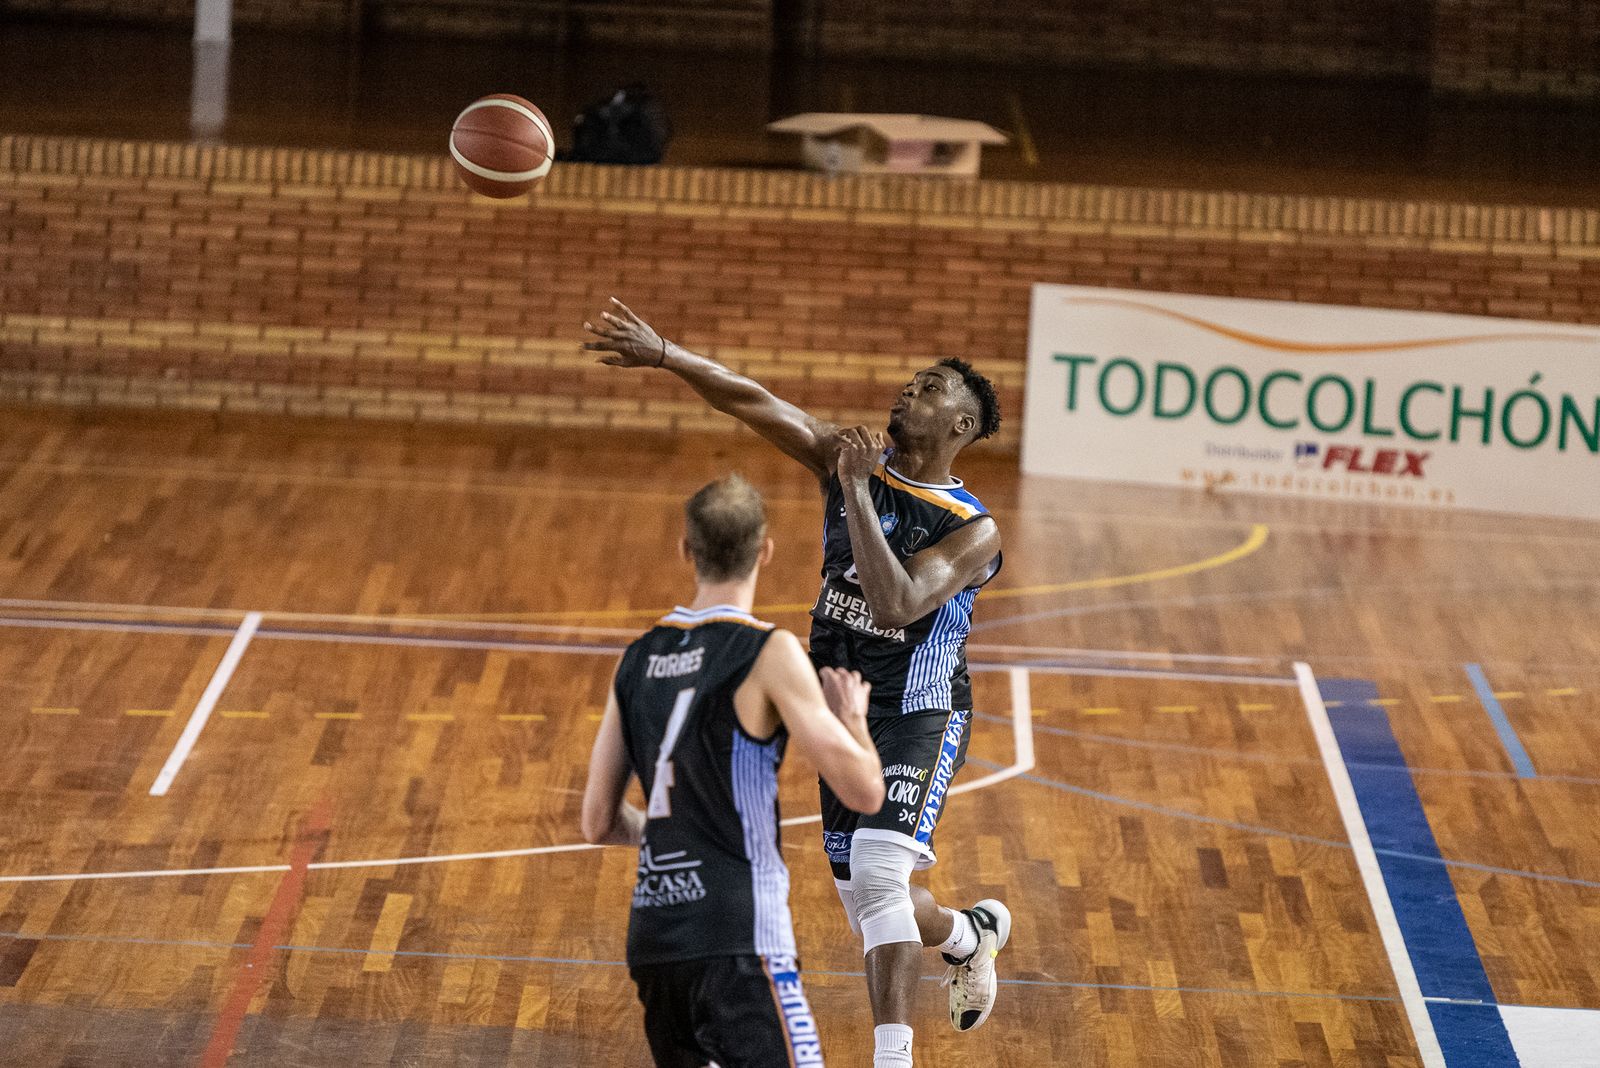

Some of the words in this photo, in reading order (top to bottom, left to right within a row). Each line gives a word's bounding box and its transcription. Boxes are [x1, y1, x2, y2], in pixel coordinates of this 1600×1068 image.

[1051, 353, 1600, 454] TODOCOLCHÓN
[1322, 443, 1431, 478] FLEX
[824, 602, 845, 621] TE
[826, 588, 873, 618] HUEL
[646, 647, 705, 678] TORRES
[888, 780, 920, 806] ORO
[919, 751, 954, 835] HUELVA
[823, 835, 848, 850] Ford
